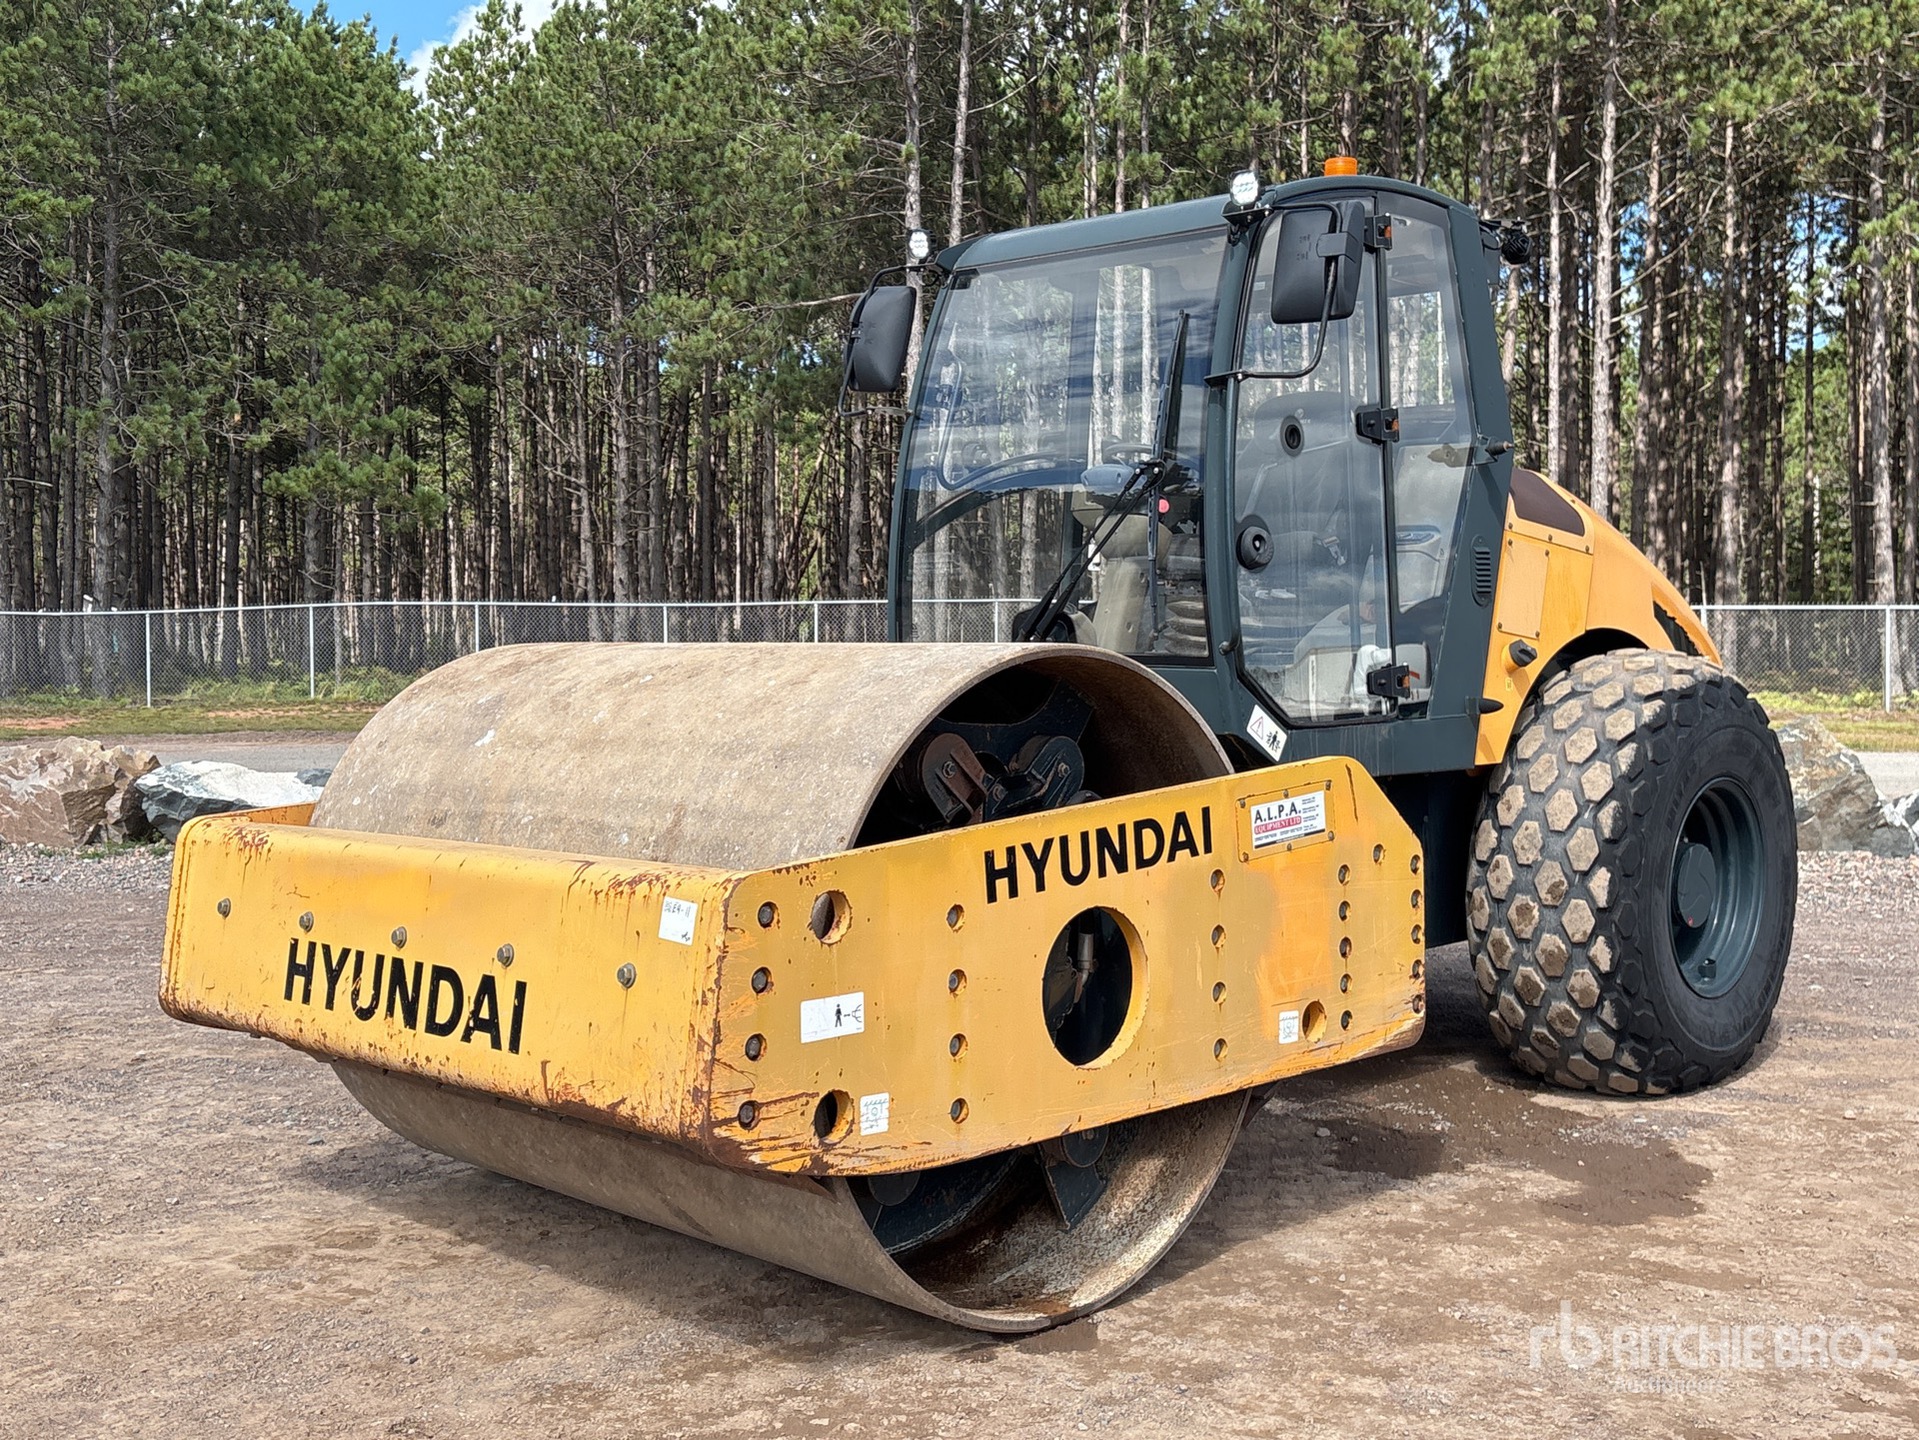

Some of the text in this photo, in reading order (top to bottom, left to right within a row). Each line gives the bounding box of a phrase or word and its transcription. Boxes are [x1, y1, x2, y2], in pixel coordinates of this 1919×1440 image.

[1254, 802, 1302, 824] A.L.P.A.
[1254, 819, 1290, 834] EQUIPMENT
[1289, 816, 1302, 826] LTD
[984, 806, 1212, 904] HYUNDAI
[284, 938, 527, 1054] HYUNDAI
